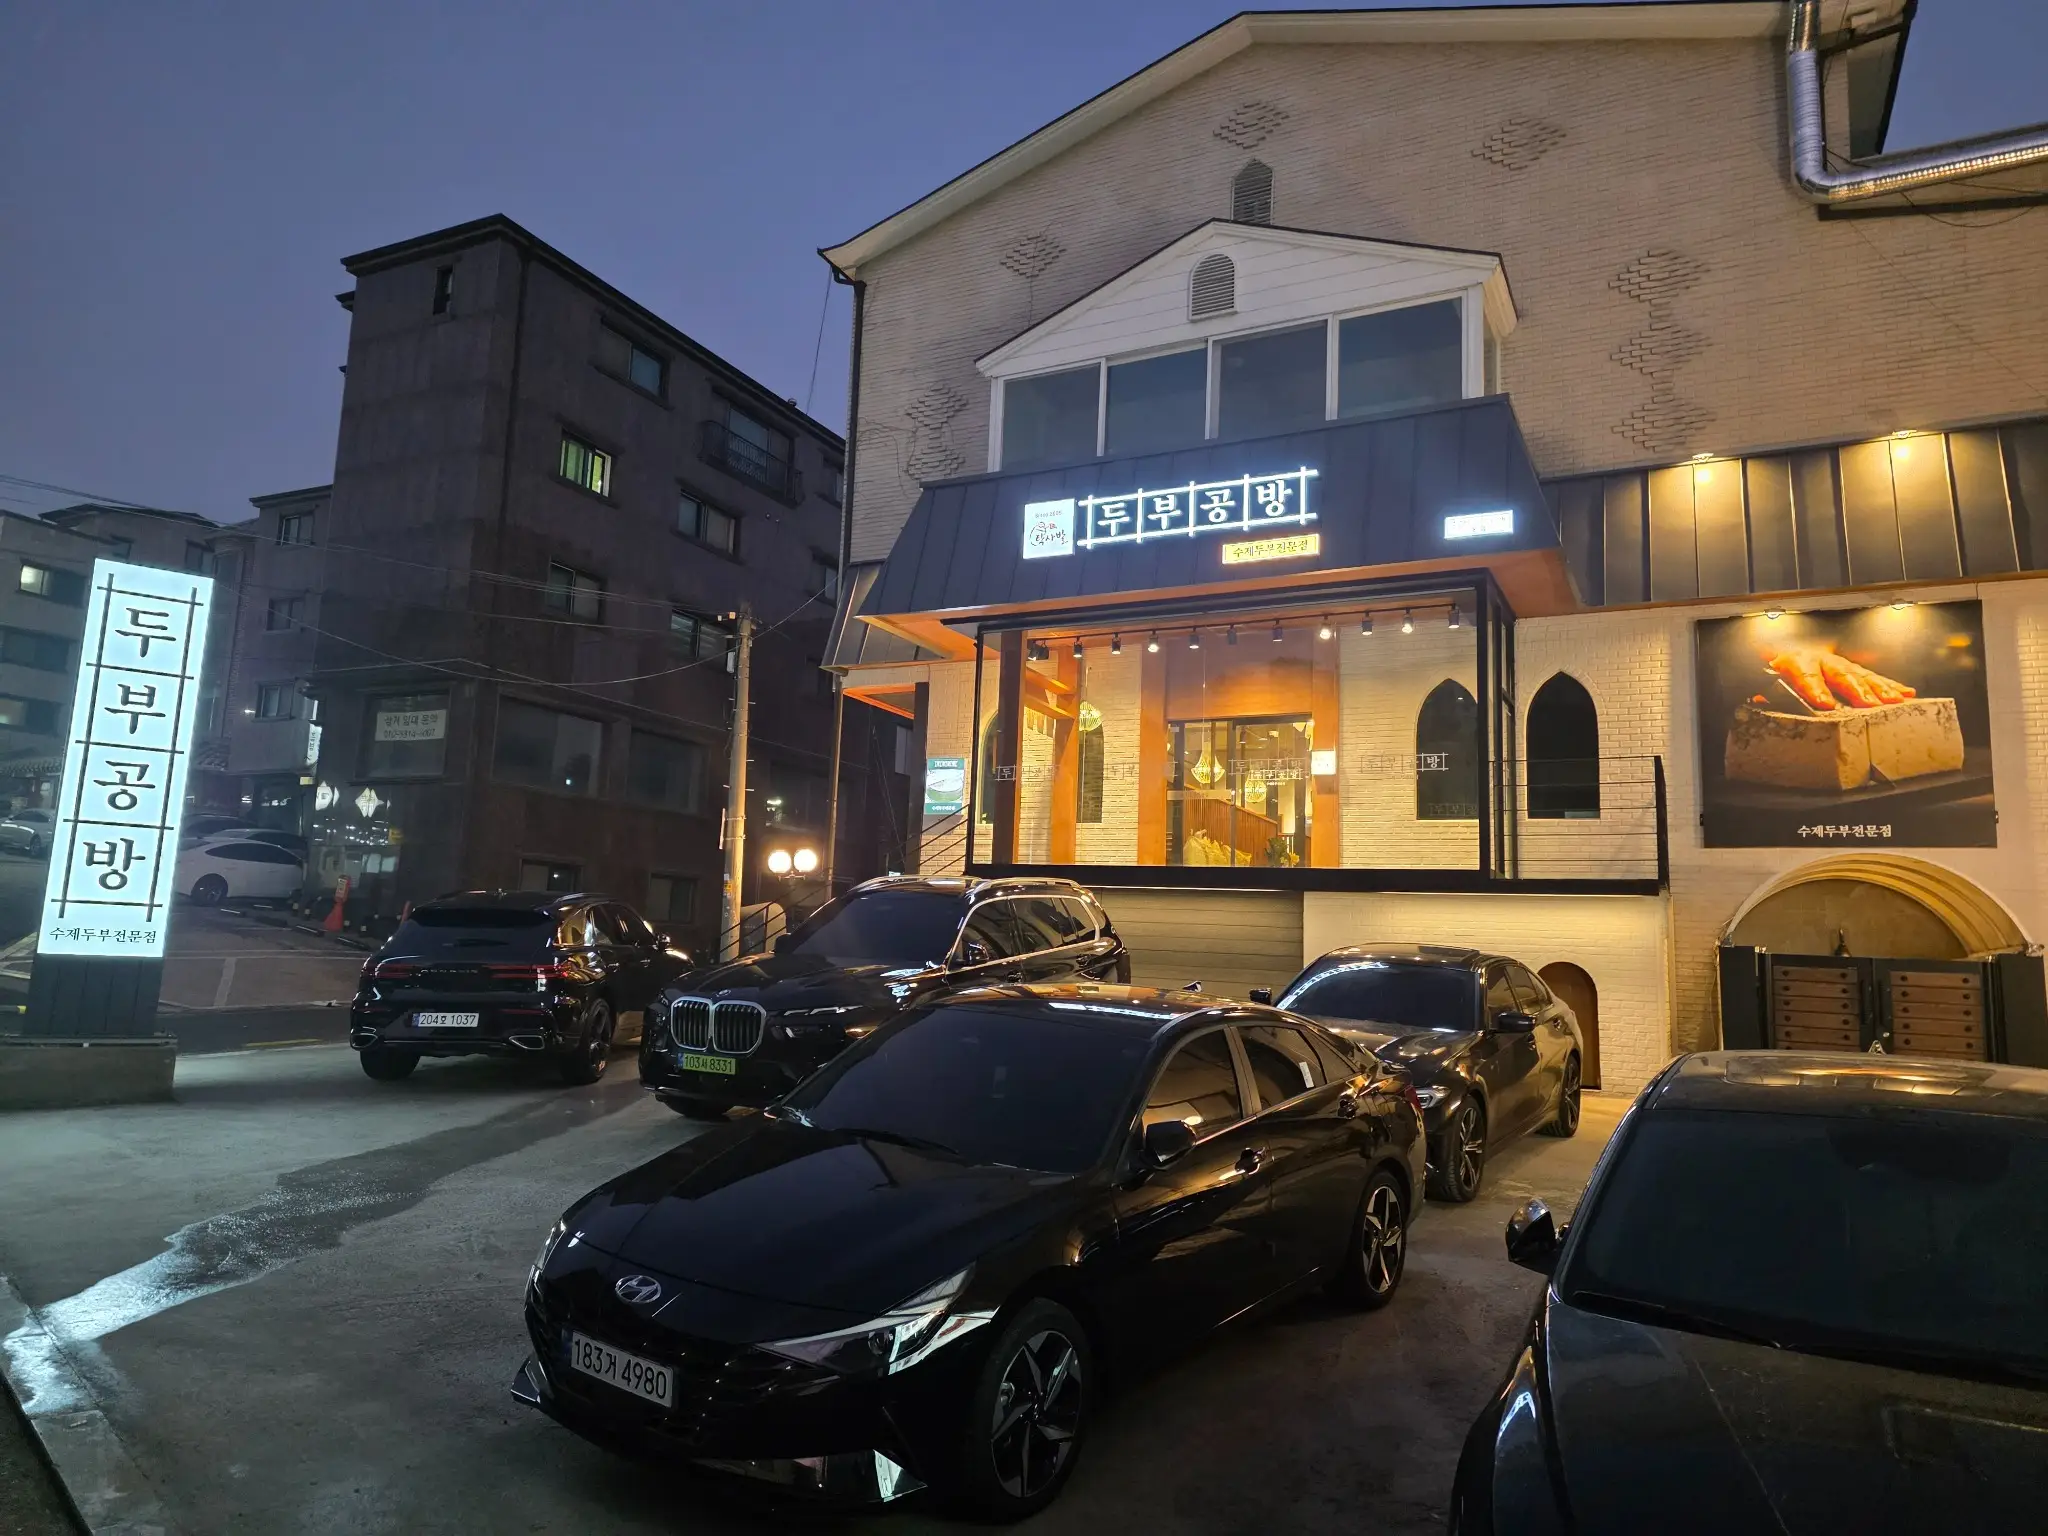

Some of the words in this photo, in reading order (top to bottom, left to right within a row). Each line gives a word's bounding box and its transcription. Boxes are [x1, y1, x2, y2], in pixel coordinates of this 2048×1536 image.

[1097, 479, 1294, 537] 두부공방
[1232, 539, 1308, 558] 수제두부전문점
[83, 606, 177, 891] 두부공방
[1797, 825, 1893, 839] 수제두부전문점
[48, 926, 157, 944] 수제두부전문점
[450, 1014, 477, 1025] 1037
[710, 1058, 732, 1073] 8331
[574, 1338, 617, 1380] 183거
[621, 1358, 667, 1400] 4980
